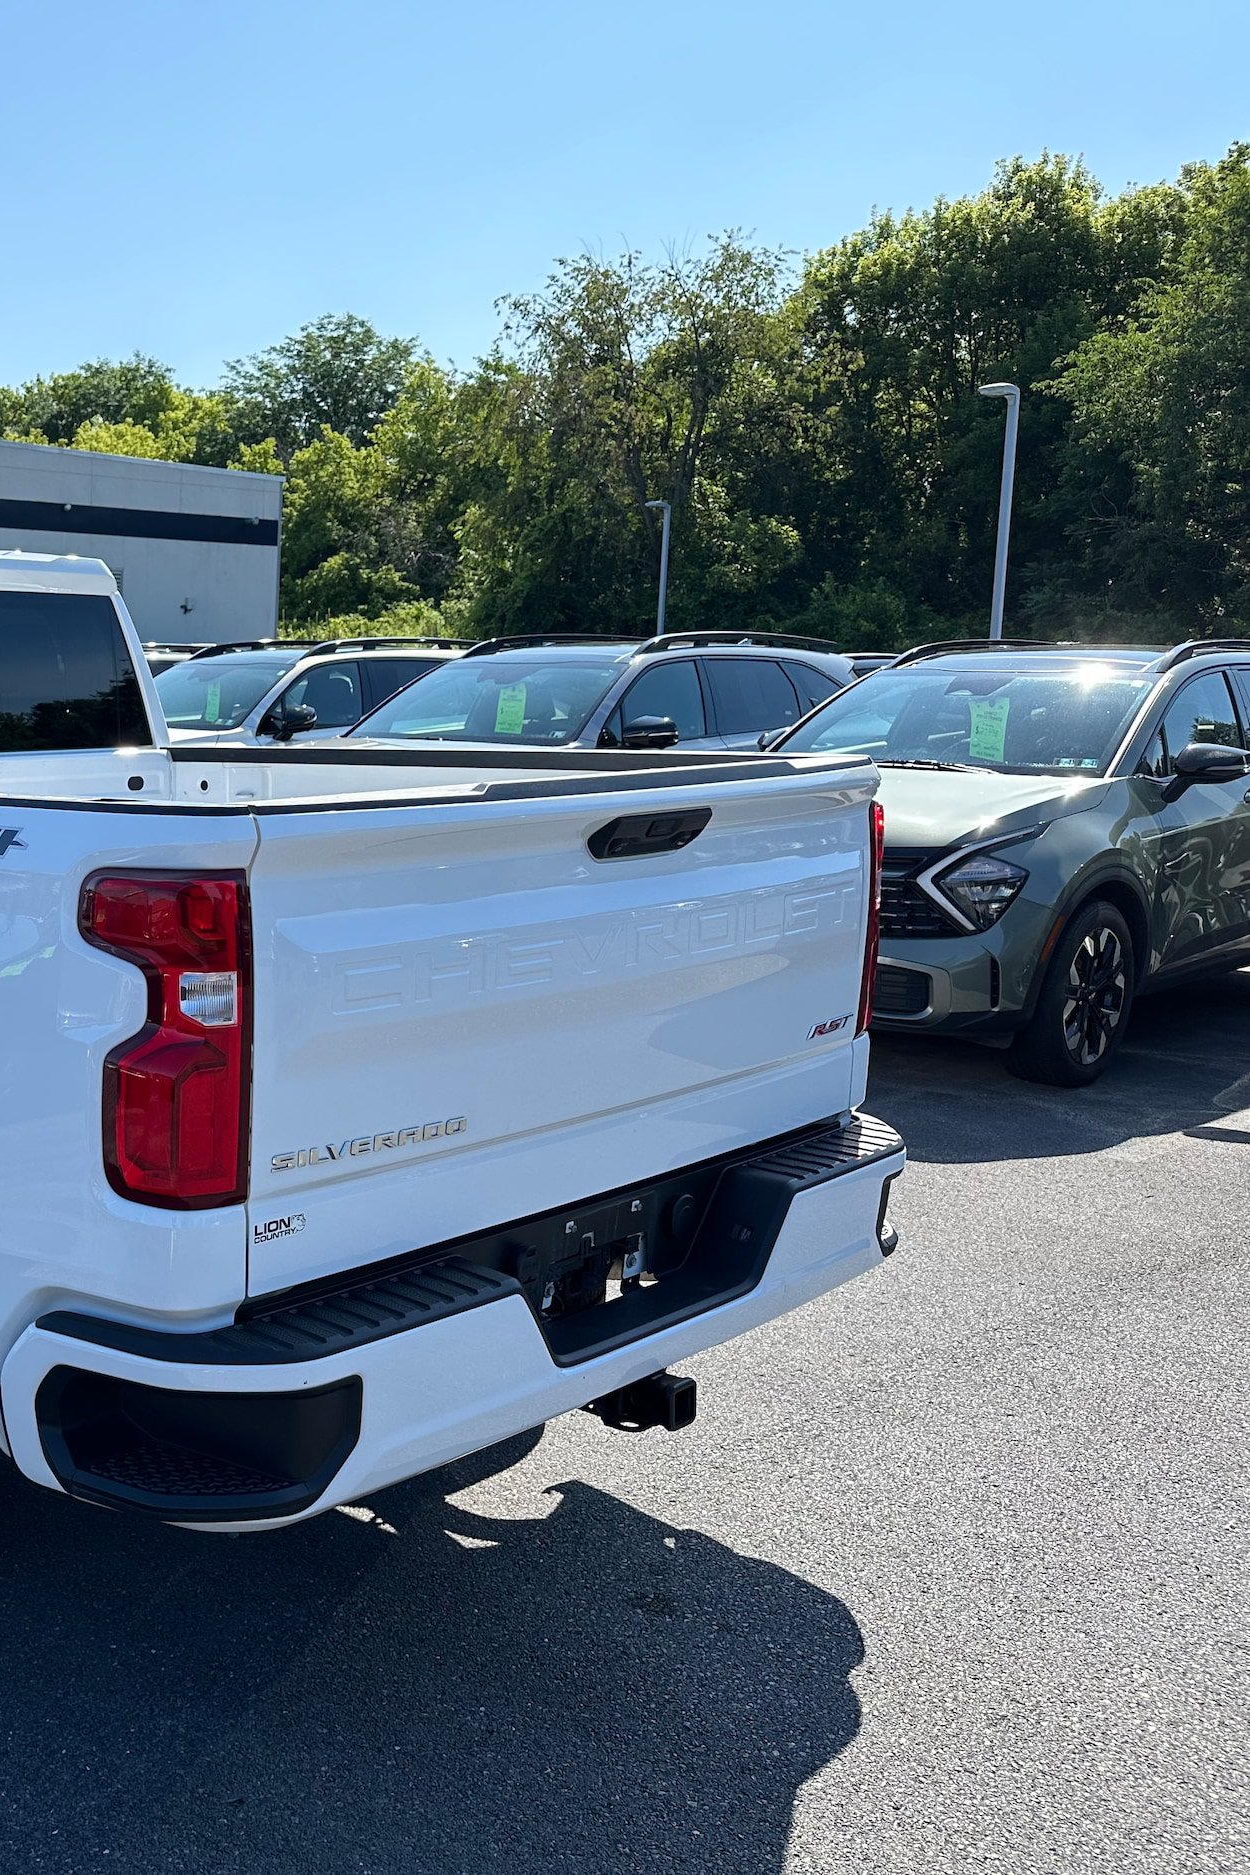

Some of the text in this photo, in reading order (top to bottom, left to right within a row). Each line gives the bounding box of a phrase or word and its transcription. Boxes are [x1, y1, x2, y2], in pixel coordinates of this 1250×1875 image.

[330, 880, 856, 1016] CHEVROLET
[806, 1012, 854, 1040] RST
[271, 1116, 467, 1173] SILVERADO
[254, 1216, 291, 1237] LION
[254, 1227, 296, 1244] COUNTRY
